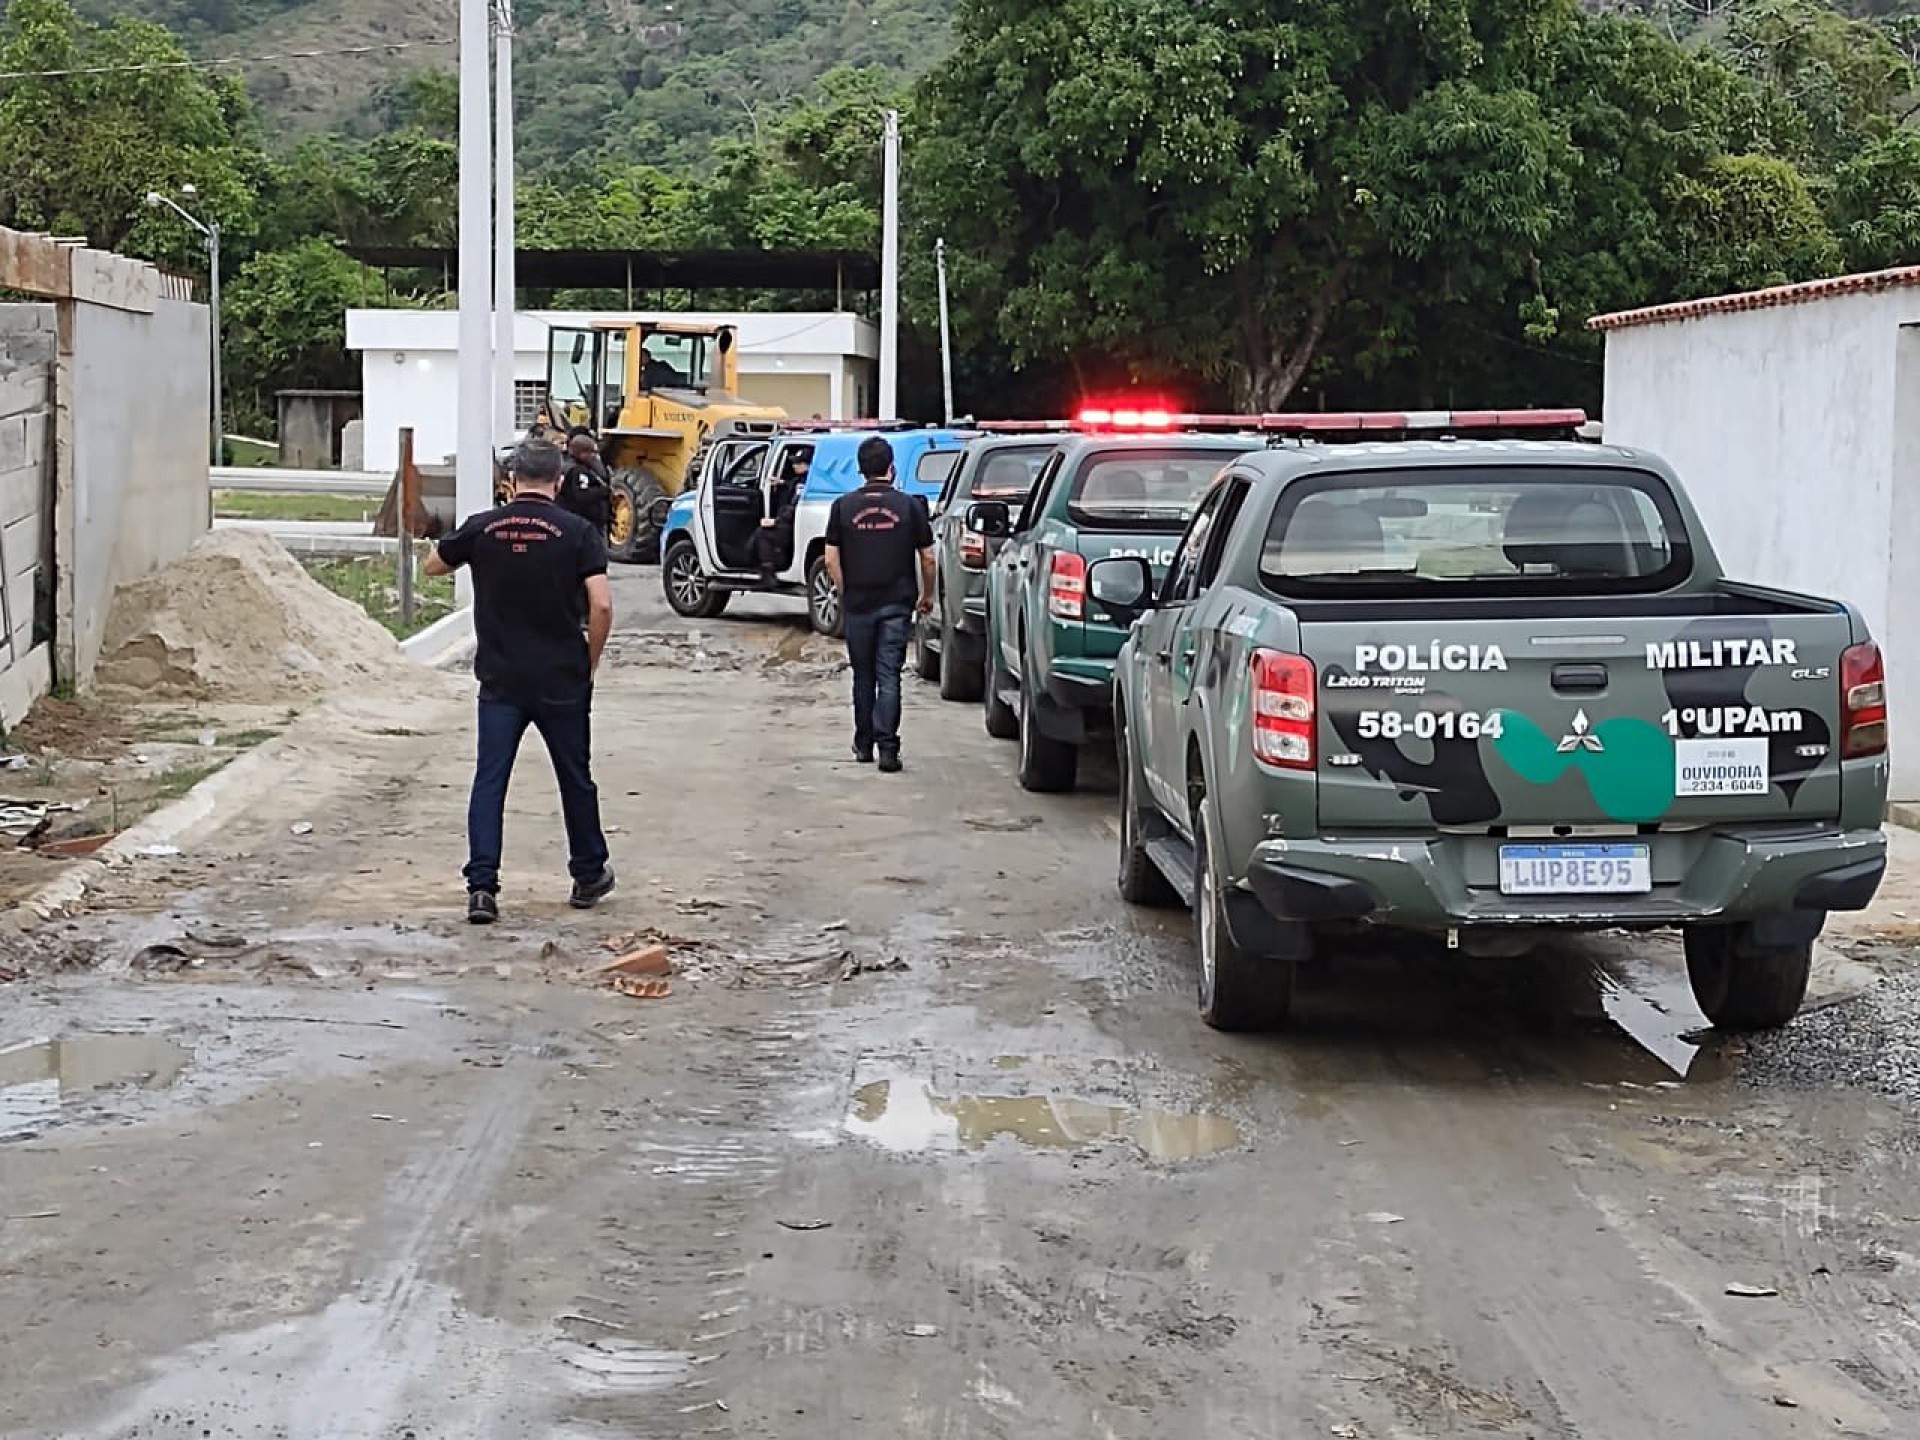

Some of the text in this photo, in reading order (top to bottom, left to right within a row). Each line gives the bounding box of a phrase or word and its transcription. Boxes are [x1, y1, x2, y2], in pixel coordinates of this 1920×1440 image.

[1355, 639, 1798, 672] POLÍCIA MILITAR
[1326, 675, 1426, 688] L200 TRITON
[1791, 667, 1830, 680] GLS
[1357, 709, 1504, 739] 58-0164
[1682, 765, 1763, 781] OUVIDORIA
[1514, 860, 1632, 887] LUP8E95
